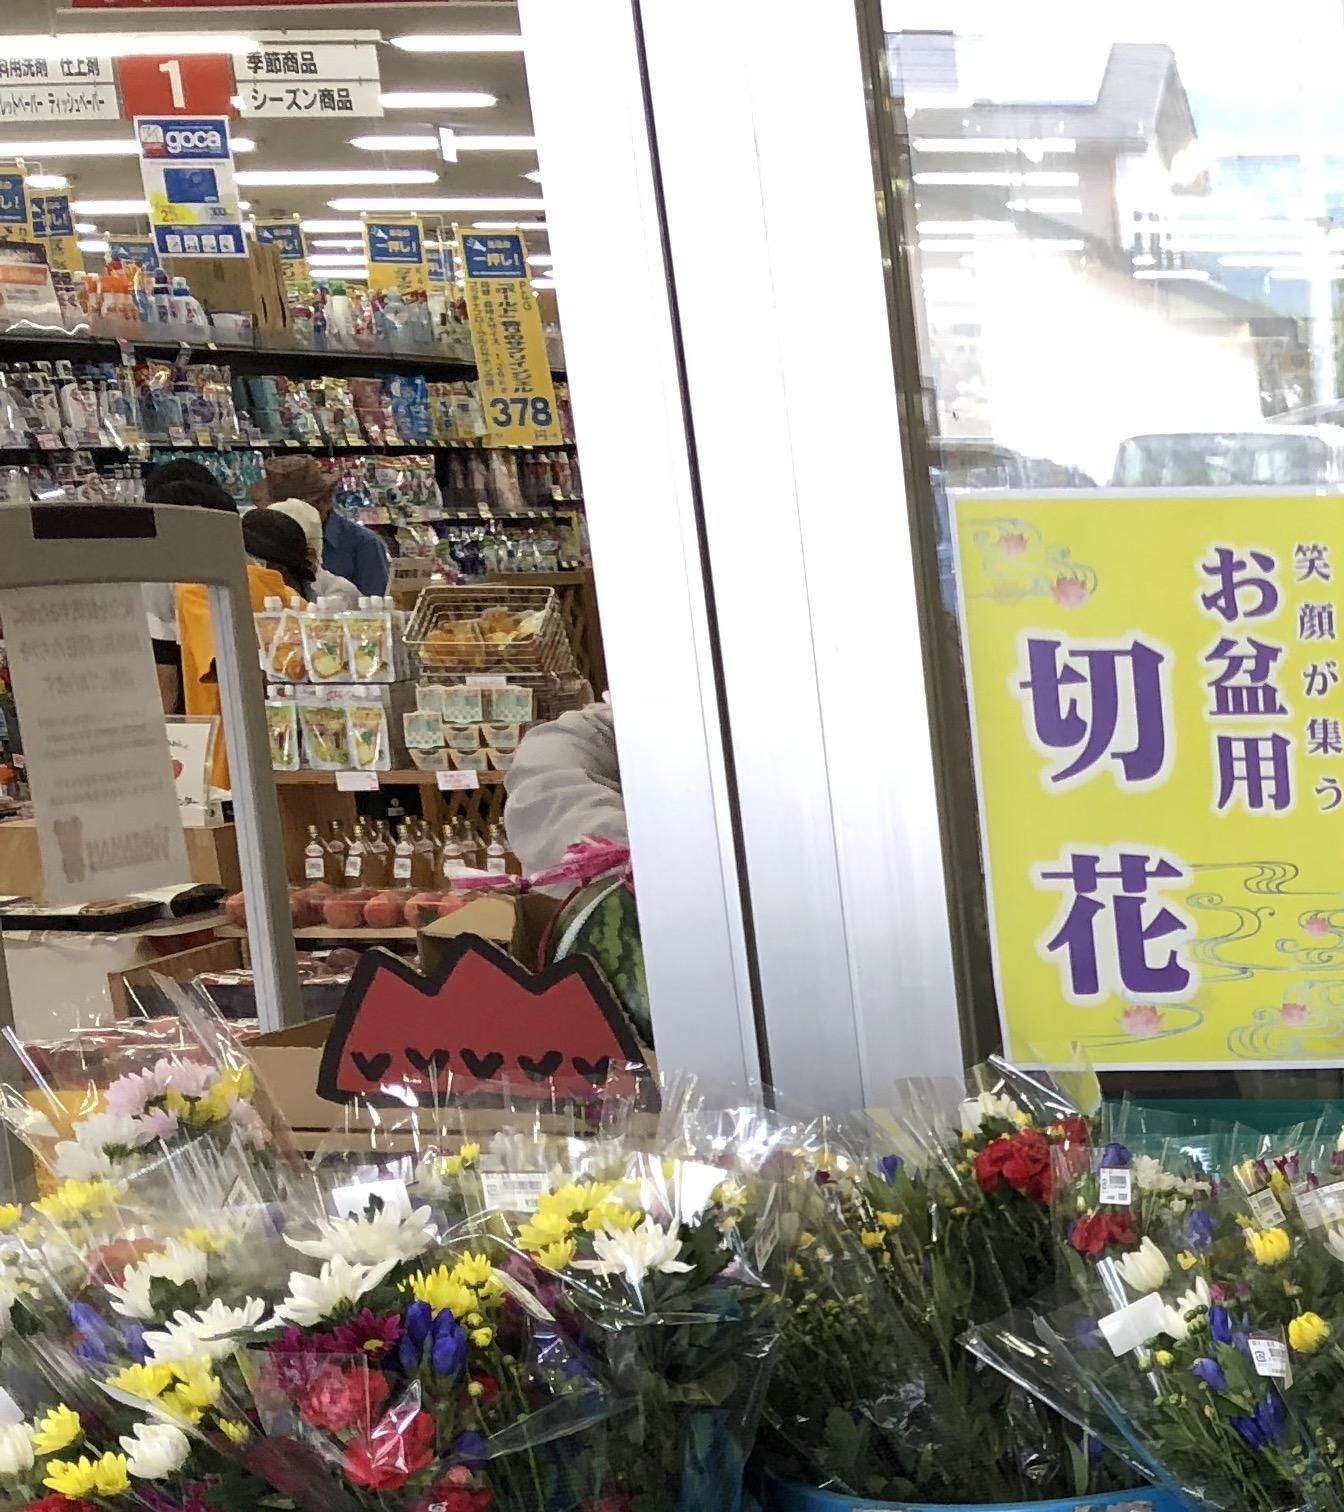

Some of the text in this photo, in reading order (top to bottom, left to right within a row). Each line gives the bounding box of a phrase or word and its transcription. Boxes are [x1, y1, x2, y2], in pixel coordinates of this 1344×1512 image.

[246, 51, 318, 75] 季節商品
[158, 60, 186, 108] 1
[252, 87, 353, 112] シーズン商品
[165, 129, 222, 154] goca
[490, 396, 552, 428] 378
[1200, 546, 1292, 811] お盆用
[1294, 544, 1344, 812] 笑顔が集う
[1019, 637, 1192, 996] 切花
